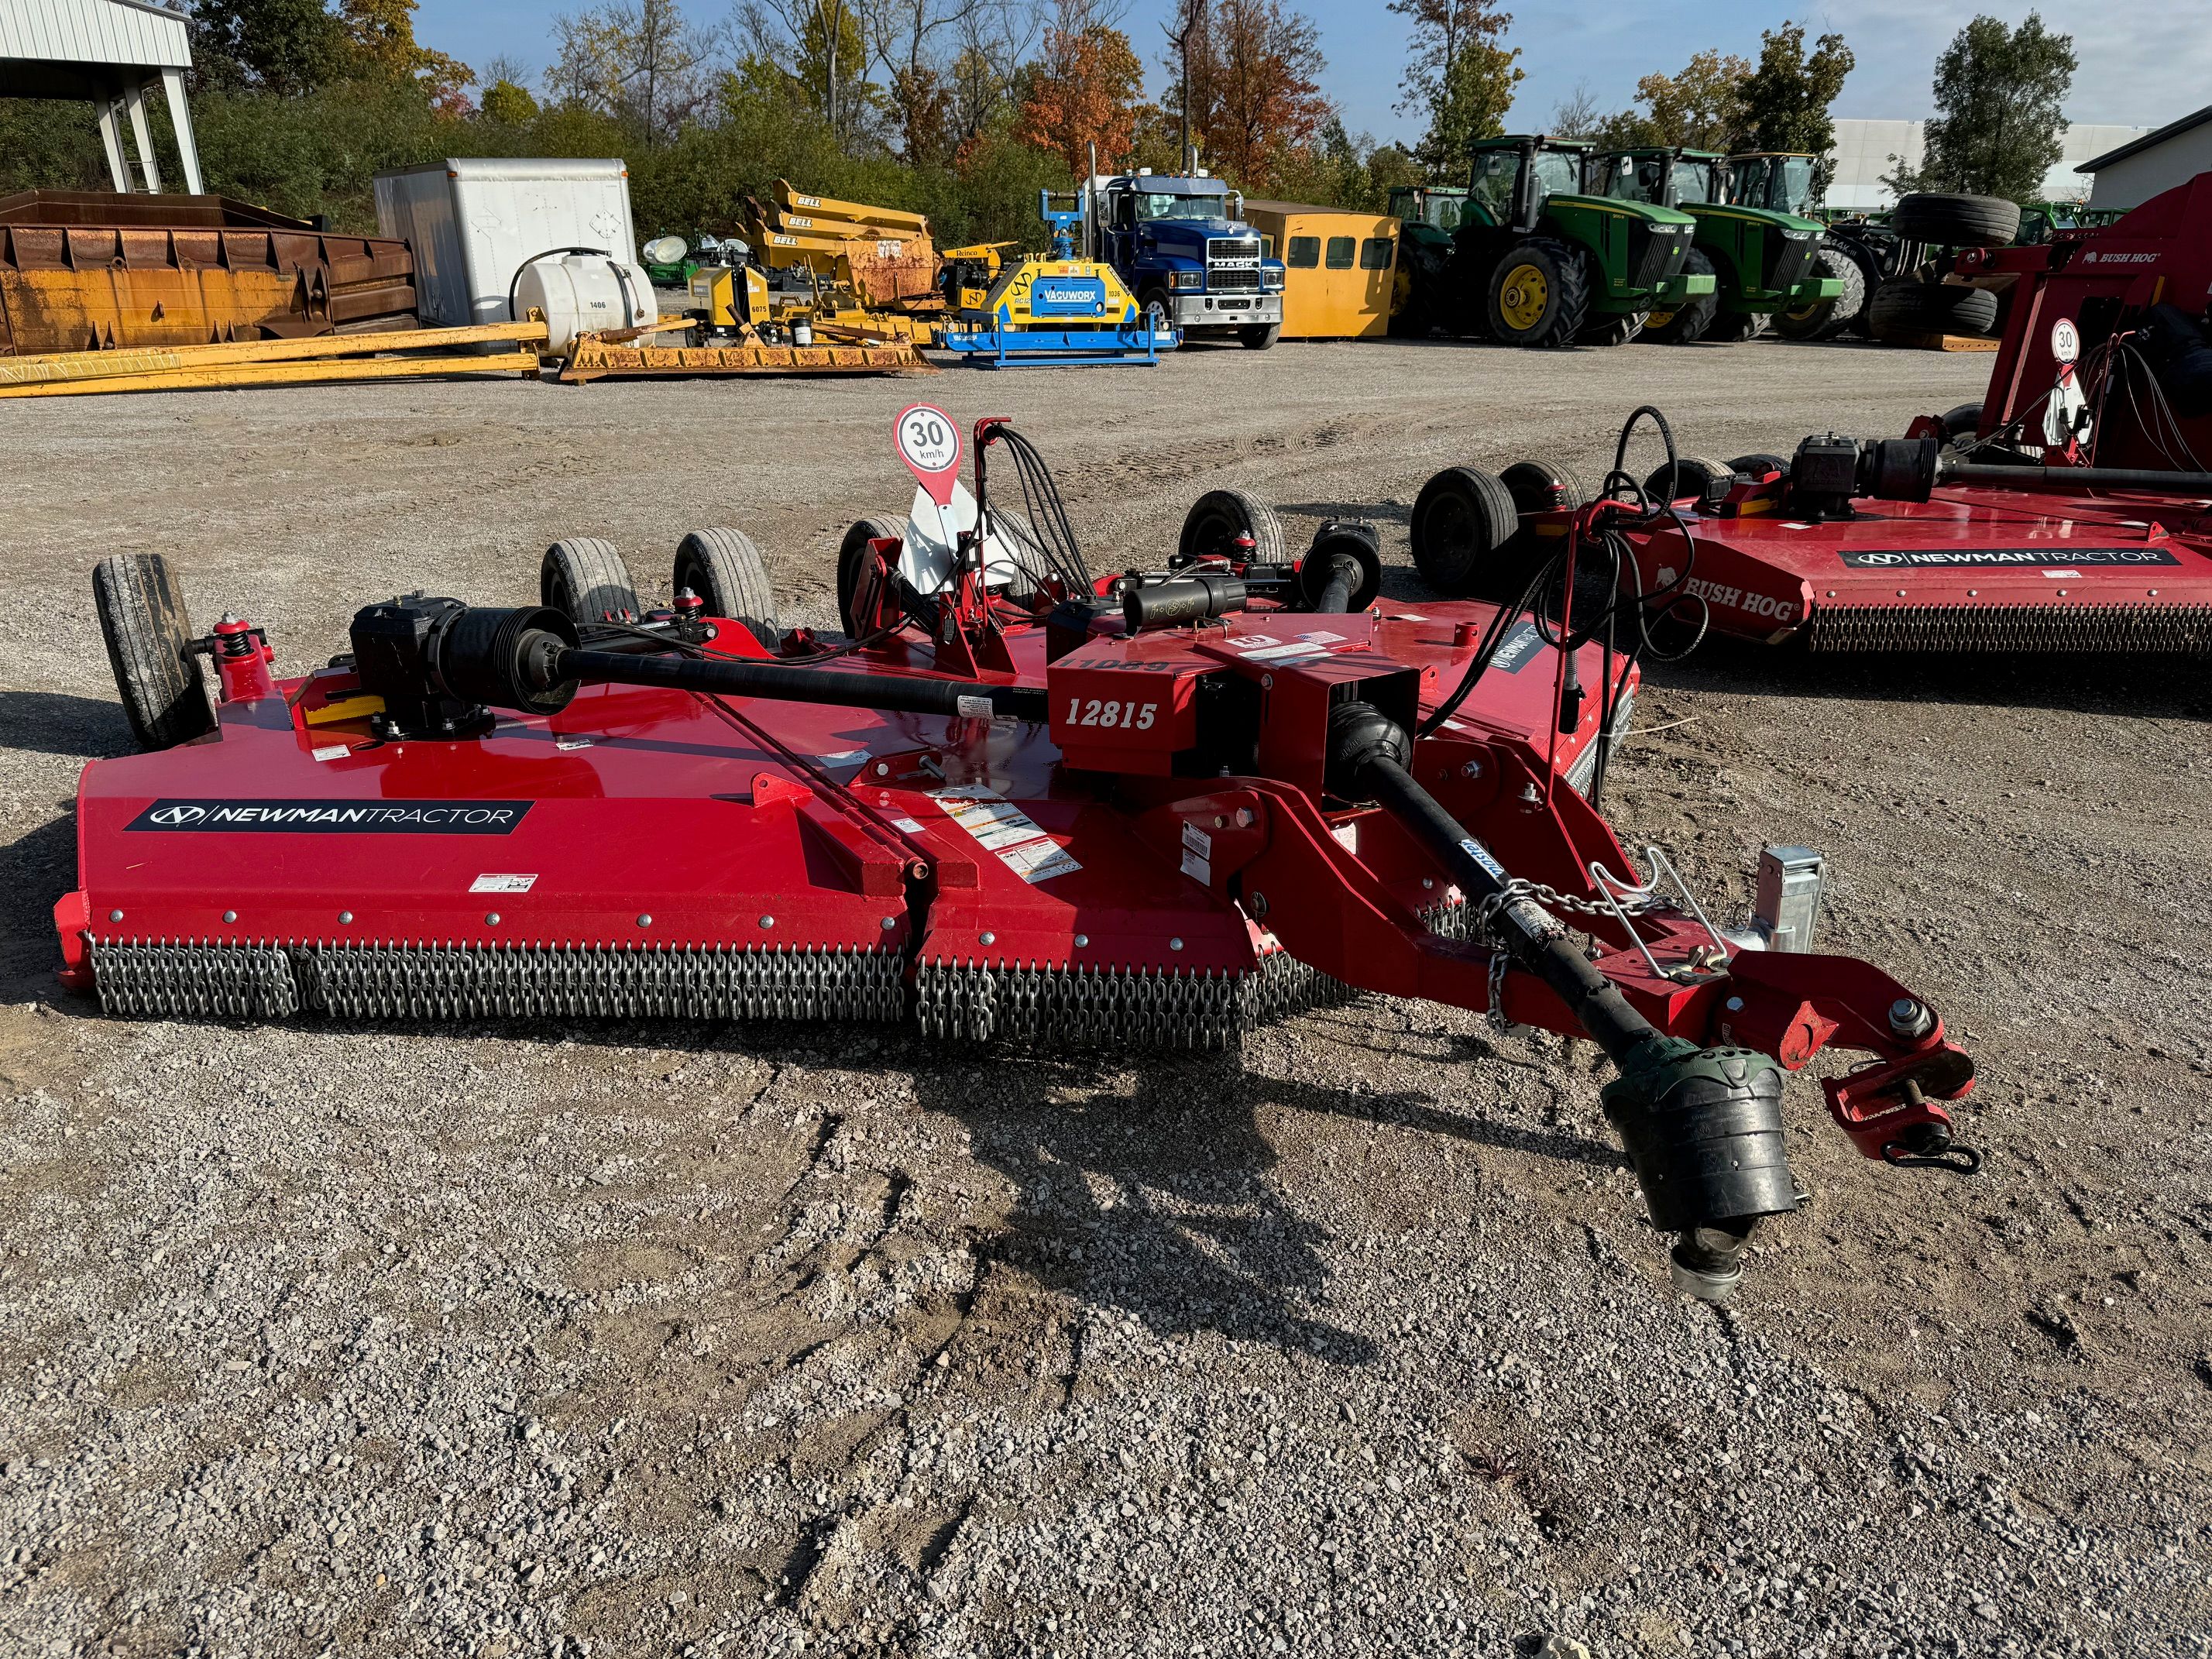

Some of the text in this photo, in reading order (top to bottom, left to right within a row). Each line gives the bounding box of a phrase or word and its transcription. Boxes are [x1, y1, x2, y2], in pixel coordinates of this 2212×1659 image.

[797, 196, 821, 208] BELL
[788, 217, 812, 228] BELL
[773, 235, 798, 246] BELL
[2099, 253, 2131, 263] BUSH
[1044, 290, 1096, 301] VACUWORX
[2059, 331, 2072, 348] 30
[910, 421, 943, 447] 30
[919, 449, 944, 459] km/h
[1911, 551, 2162, 563] NEWMANTRACTOR
[1683, 577, 1742, 607] BUSH
[1058, 658, 1170, 672] 11089
[1066, 699, 1158, 730] 12815
[212, 808, 514, 823] NEWMANTRACTOR
